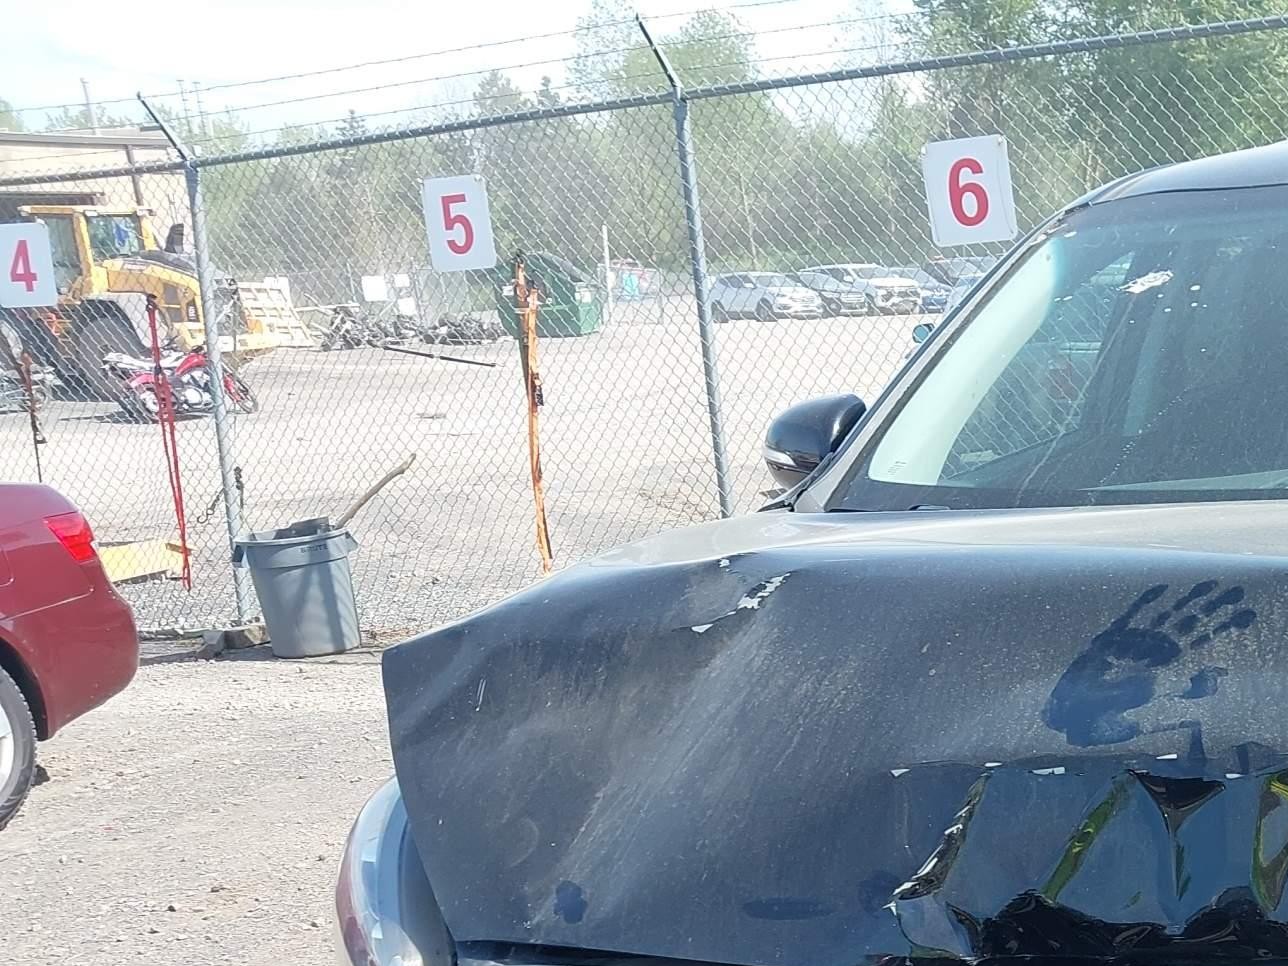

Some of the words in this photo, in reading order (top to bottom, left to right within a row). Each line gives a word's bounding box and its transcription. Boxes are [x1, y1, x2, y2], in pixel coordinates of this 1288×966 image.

[947, 157, 990, 227] 6
[440, 193, 474, 255] 5
[10, 239, 38, 292] 4
